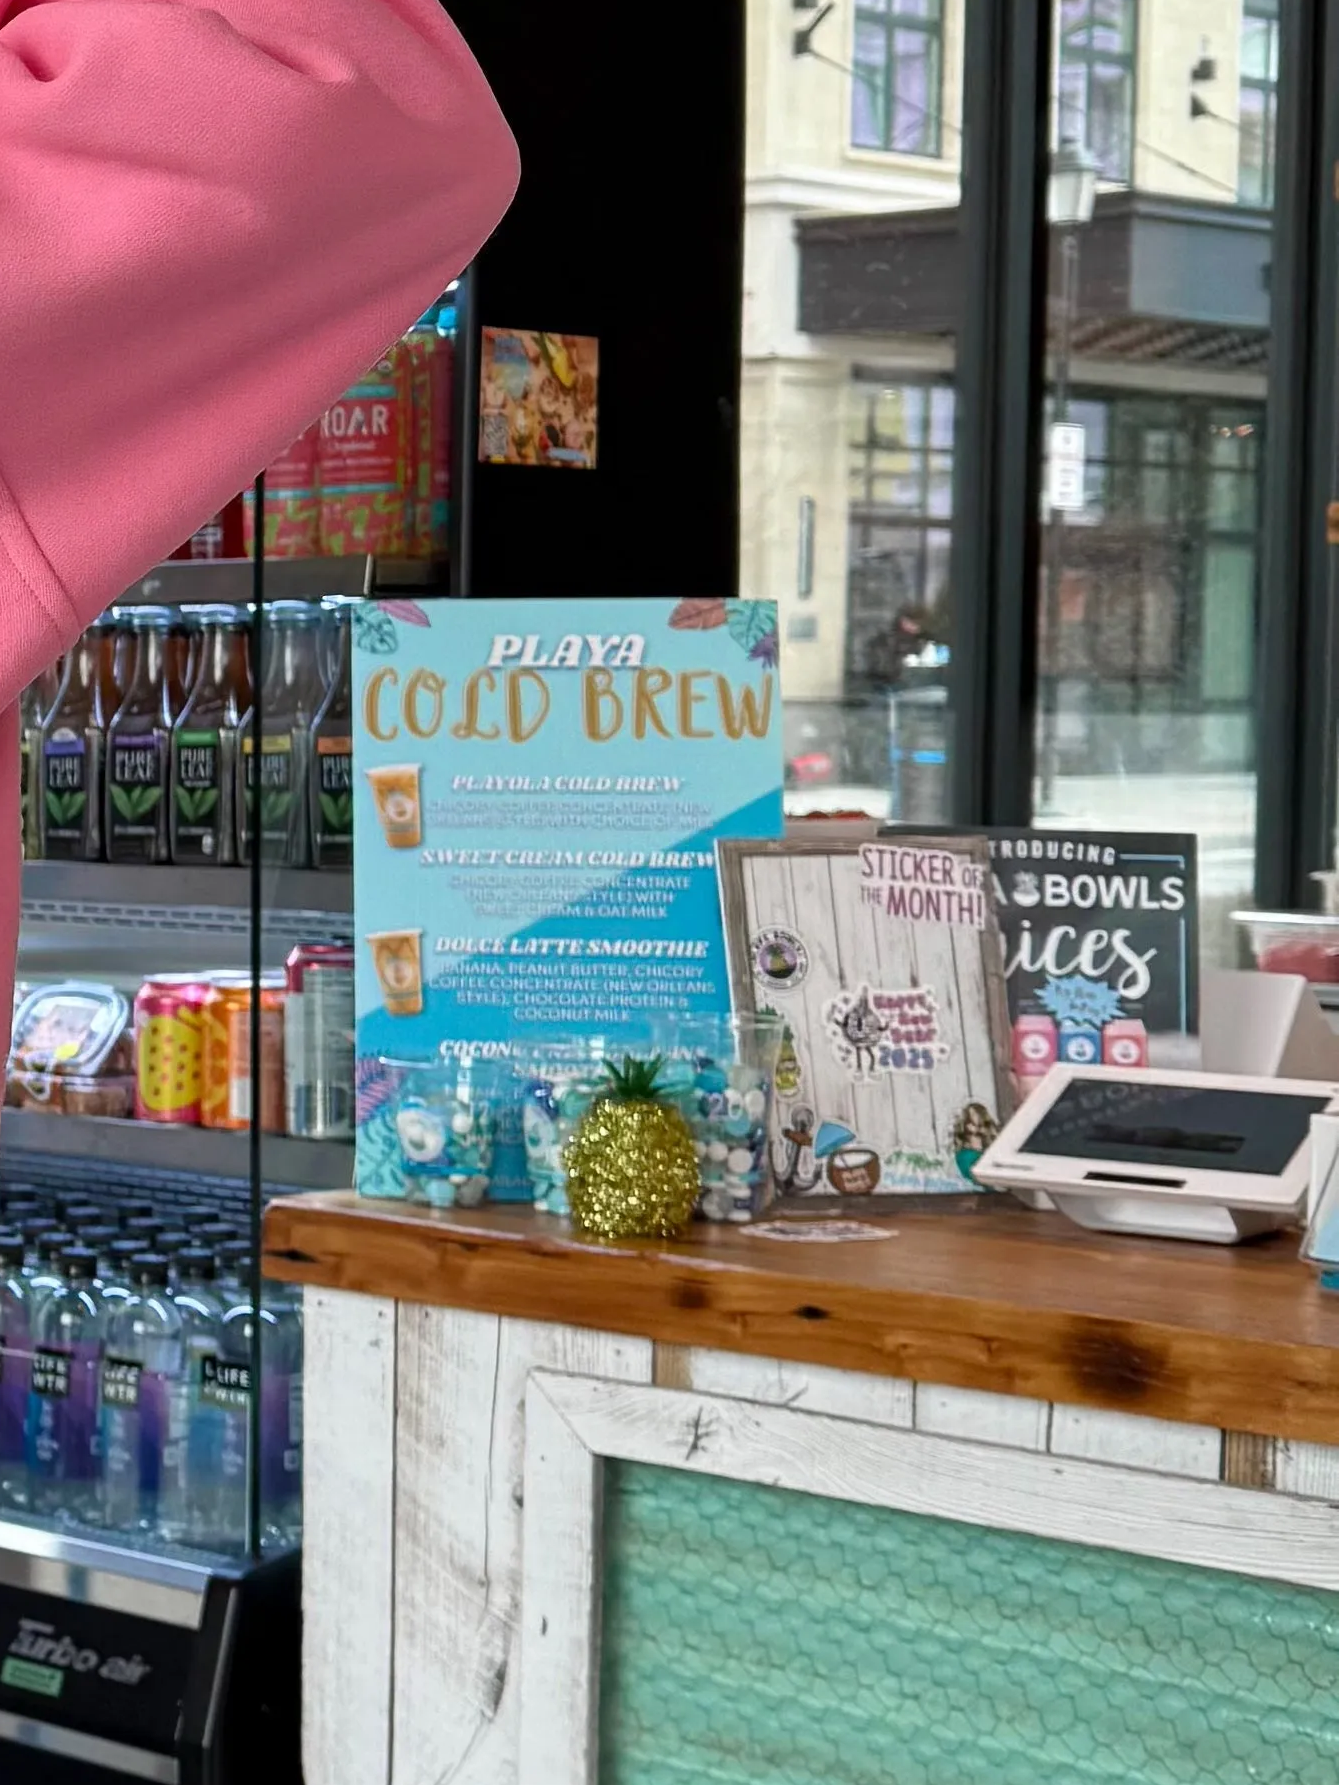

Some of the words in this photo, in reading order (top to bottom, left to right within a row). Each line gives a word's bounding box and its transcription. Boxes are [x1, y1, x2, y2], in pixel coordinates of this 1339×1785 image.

[487, 633, 645, 668] PLAYA
[362, 666, 550, 744] COLD
[581, 666, 773, 742] BREW
[554, 775, 611, 792] COLD
[421, 848, 502, 865] SWEET
[588, 851, 644, 867] COLD
[862, 848, 956, 885] STICKER
[862, 885, 883, 906] THE
[886, 885, 984, 925] MONTH!
[1044, 874, 1185, 910] BOWLS
[436, 937, 504, 955] DOLCE
[510, 937, 583, 956] LATTE
[586, 939, 709, 958] SMOOTHIE
